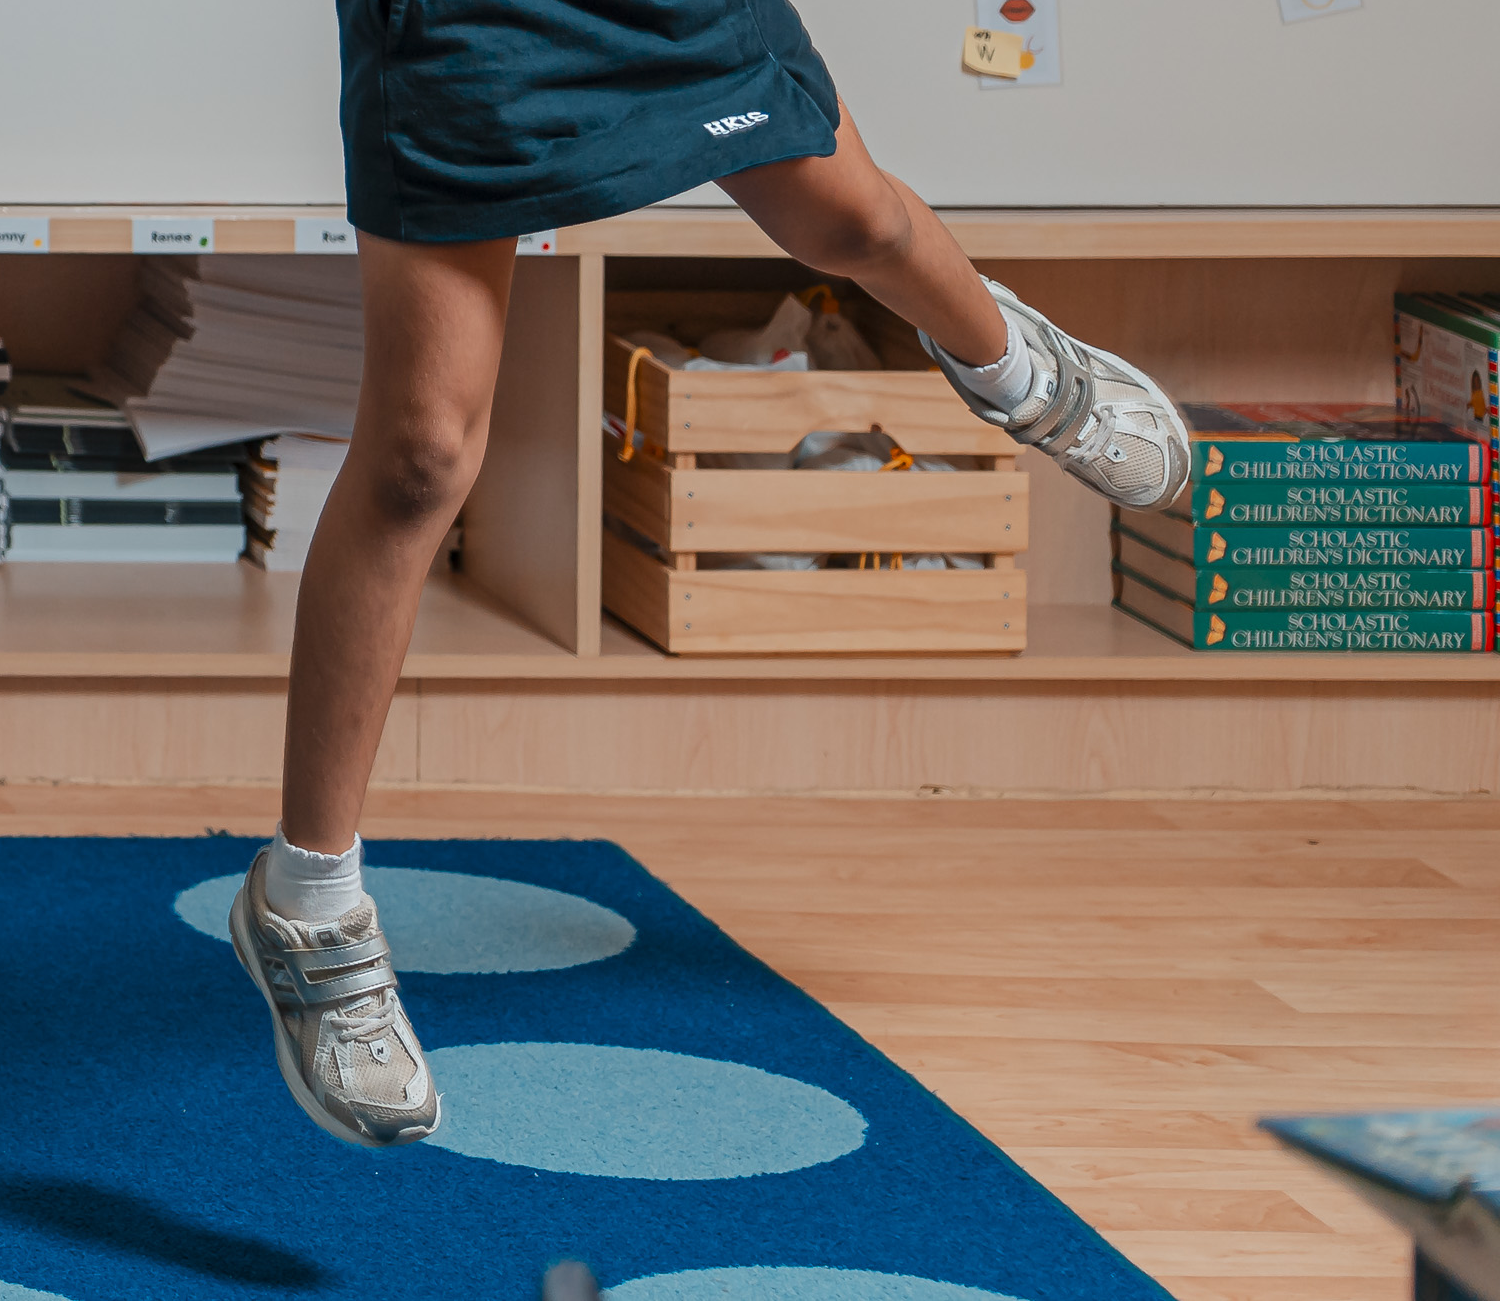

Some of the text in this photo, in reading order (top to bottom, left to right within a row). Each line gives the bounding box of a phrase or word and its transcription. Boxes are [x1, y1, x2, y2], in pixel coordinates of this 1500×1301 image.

[703, 111, 769, 136] HKIS
[151, 231, 192, 243] Renee
[322, 231, 346, 243] Rue
[1285, 446, 1407, 462] SCHOLASTIC
[1230, 463, 1462, 480] CHILDREN'S DICTIONARY
[1287, 488, 1408, 505] SCHOLASTIC
[1231, 506, 1463, 523] CHILDREN'S DICTIONARY
[1289, 531, 1410, 548] SCHOLASTIC
[1231, 548, 1465, 566] CHILDREN'S DICTIONARY
[1290, 572, 1411, 590] SCHOLASTIC
[1233, 590, 1466, 607] CHILDREN'S DICTIONARY
[1289, 614, 1410, 631] SCHOLASTIC
[1231, 631, 1465, 649] CHILDREN'S DICTIONARY
